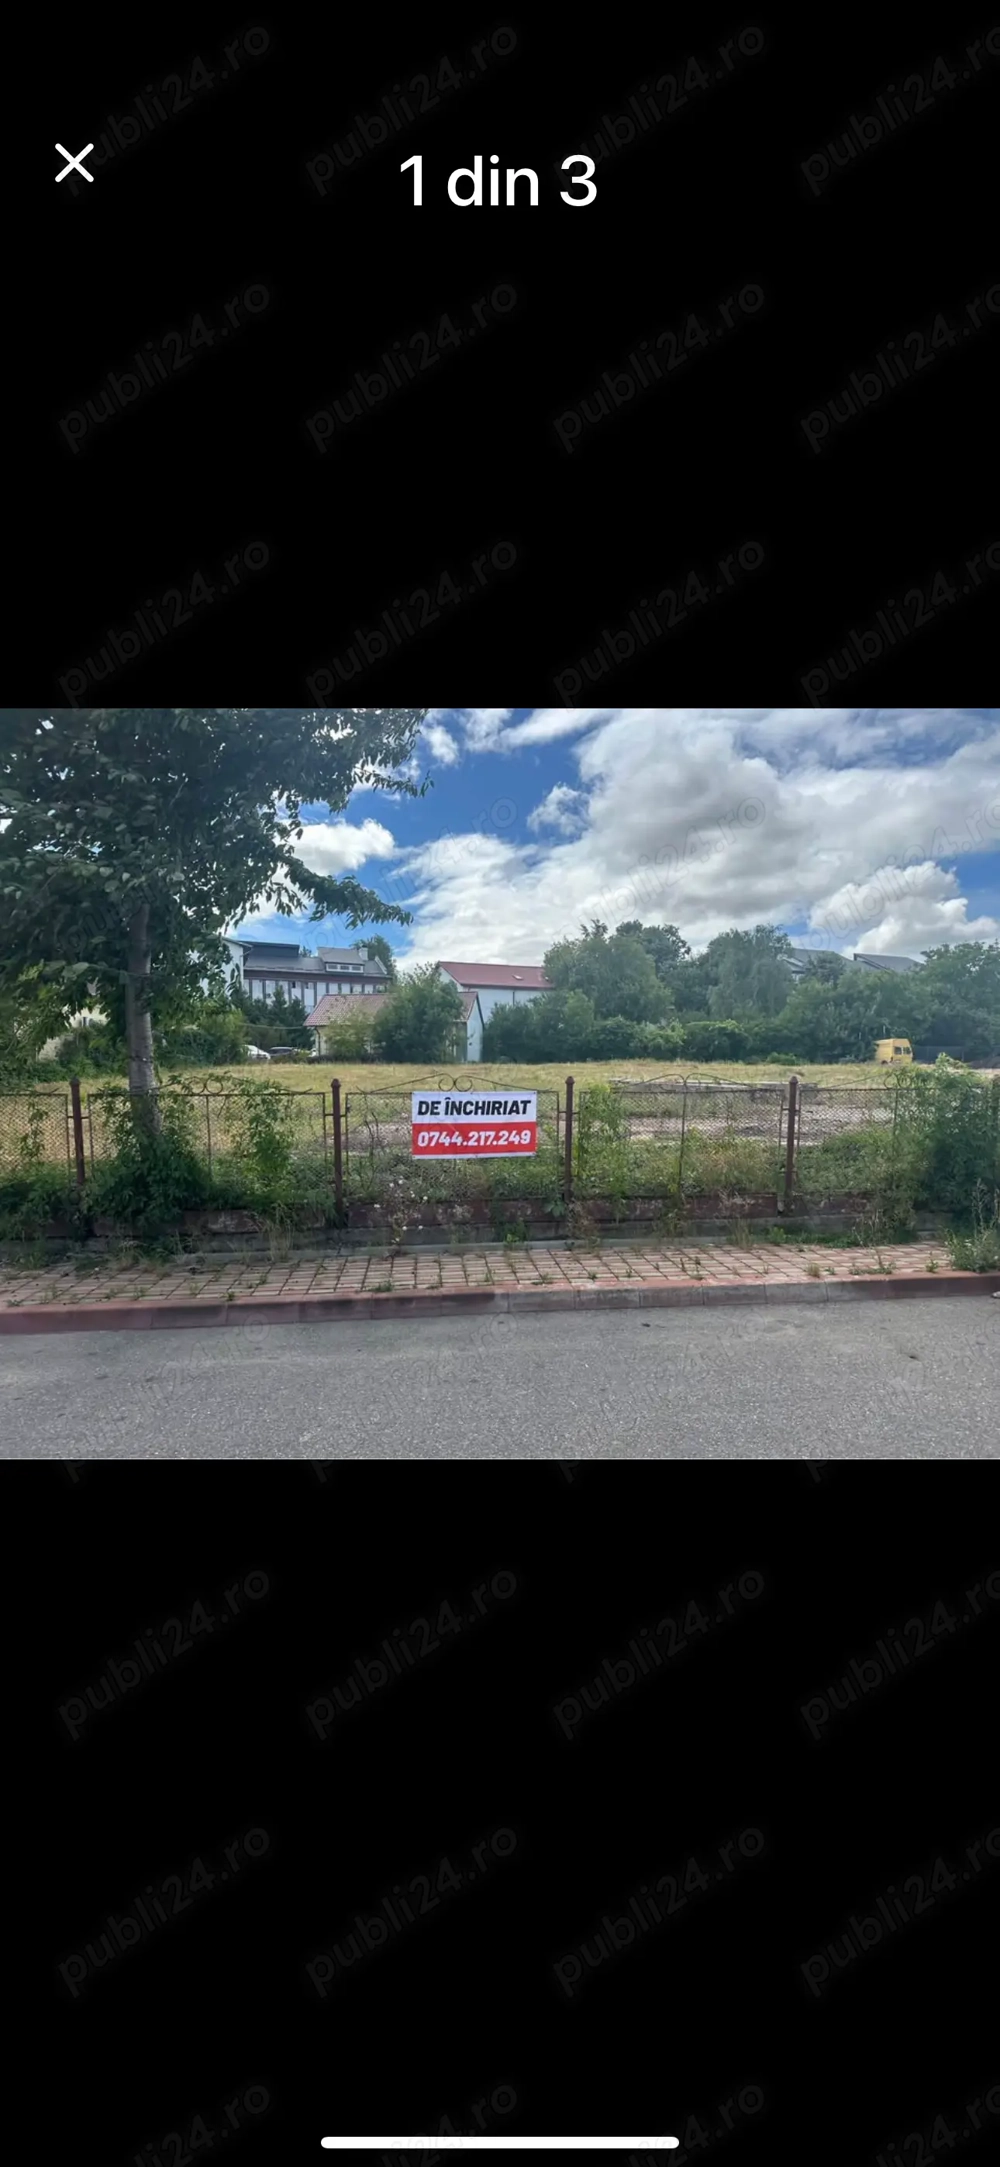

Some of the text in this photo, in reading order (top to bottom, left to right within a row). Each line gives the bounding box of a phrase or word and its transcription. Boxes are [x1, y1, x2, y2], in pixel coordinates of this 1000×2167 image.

[417, 1097, 531, 1116] DE ÎNCHIRIAT
[417, 1130, 531, 1147] 0744.217.249
